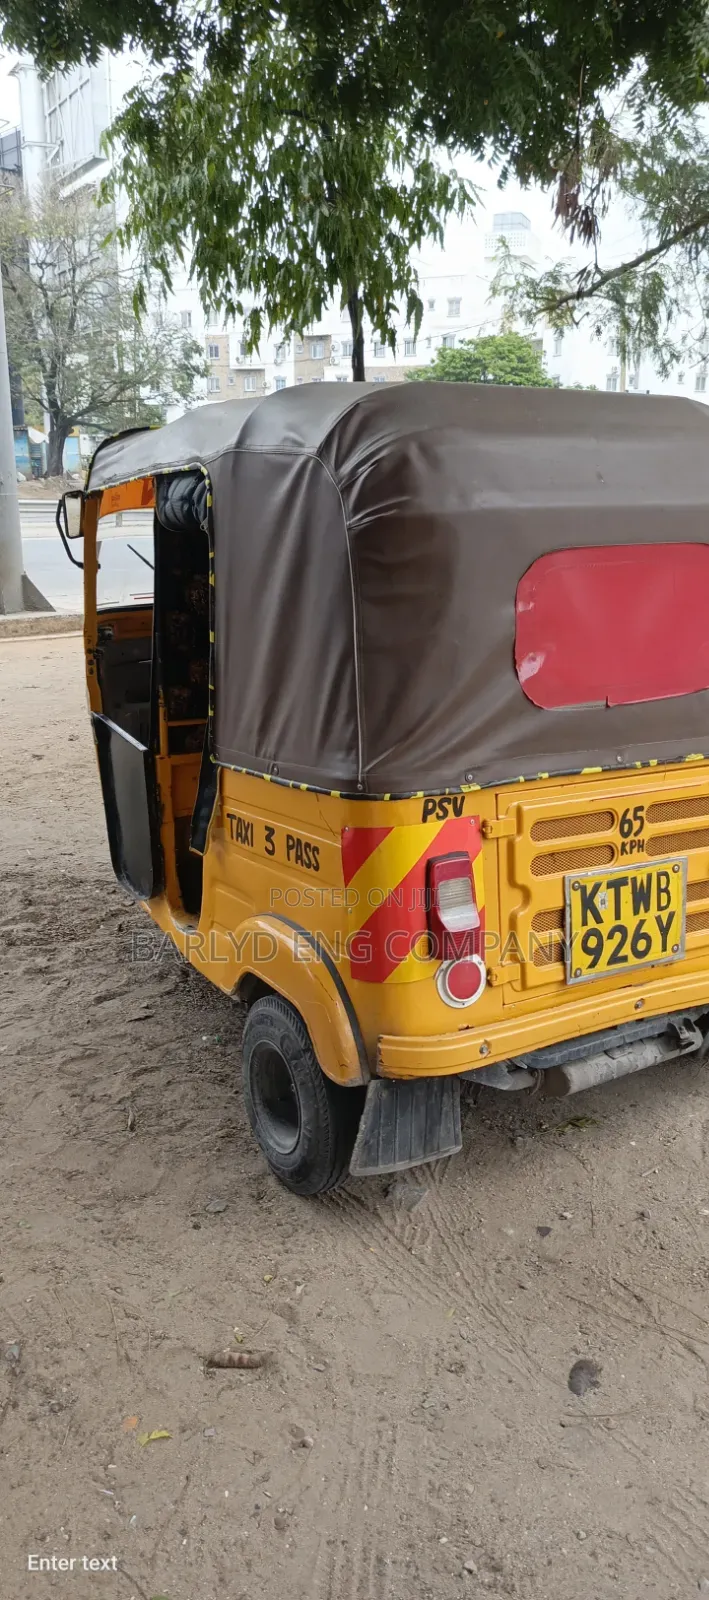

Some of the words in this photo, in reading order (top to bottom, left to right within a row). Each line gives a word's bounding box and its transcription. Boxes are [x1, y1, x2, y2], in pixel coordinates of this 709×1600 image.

[421, 795, 466, 824] PSV
[619, 805, 645, 839] 65
[226, 812, 254, 848] TAXI
[264, 825, 276, 856] 3
[286, 833, 320, 872] PASS
[620, 839, 645, 856] KPH
[580, 871, 672, 927] KTWB
[581, 911, 676, 969] 926Y
